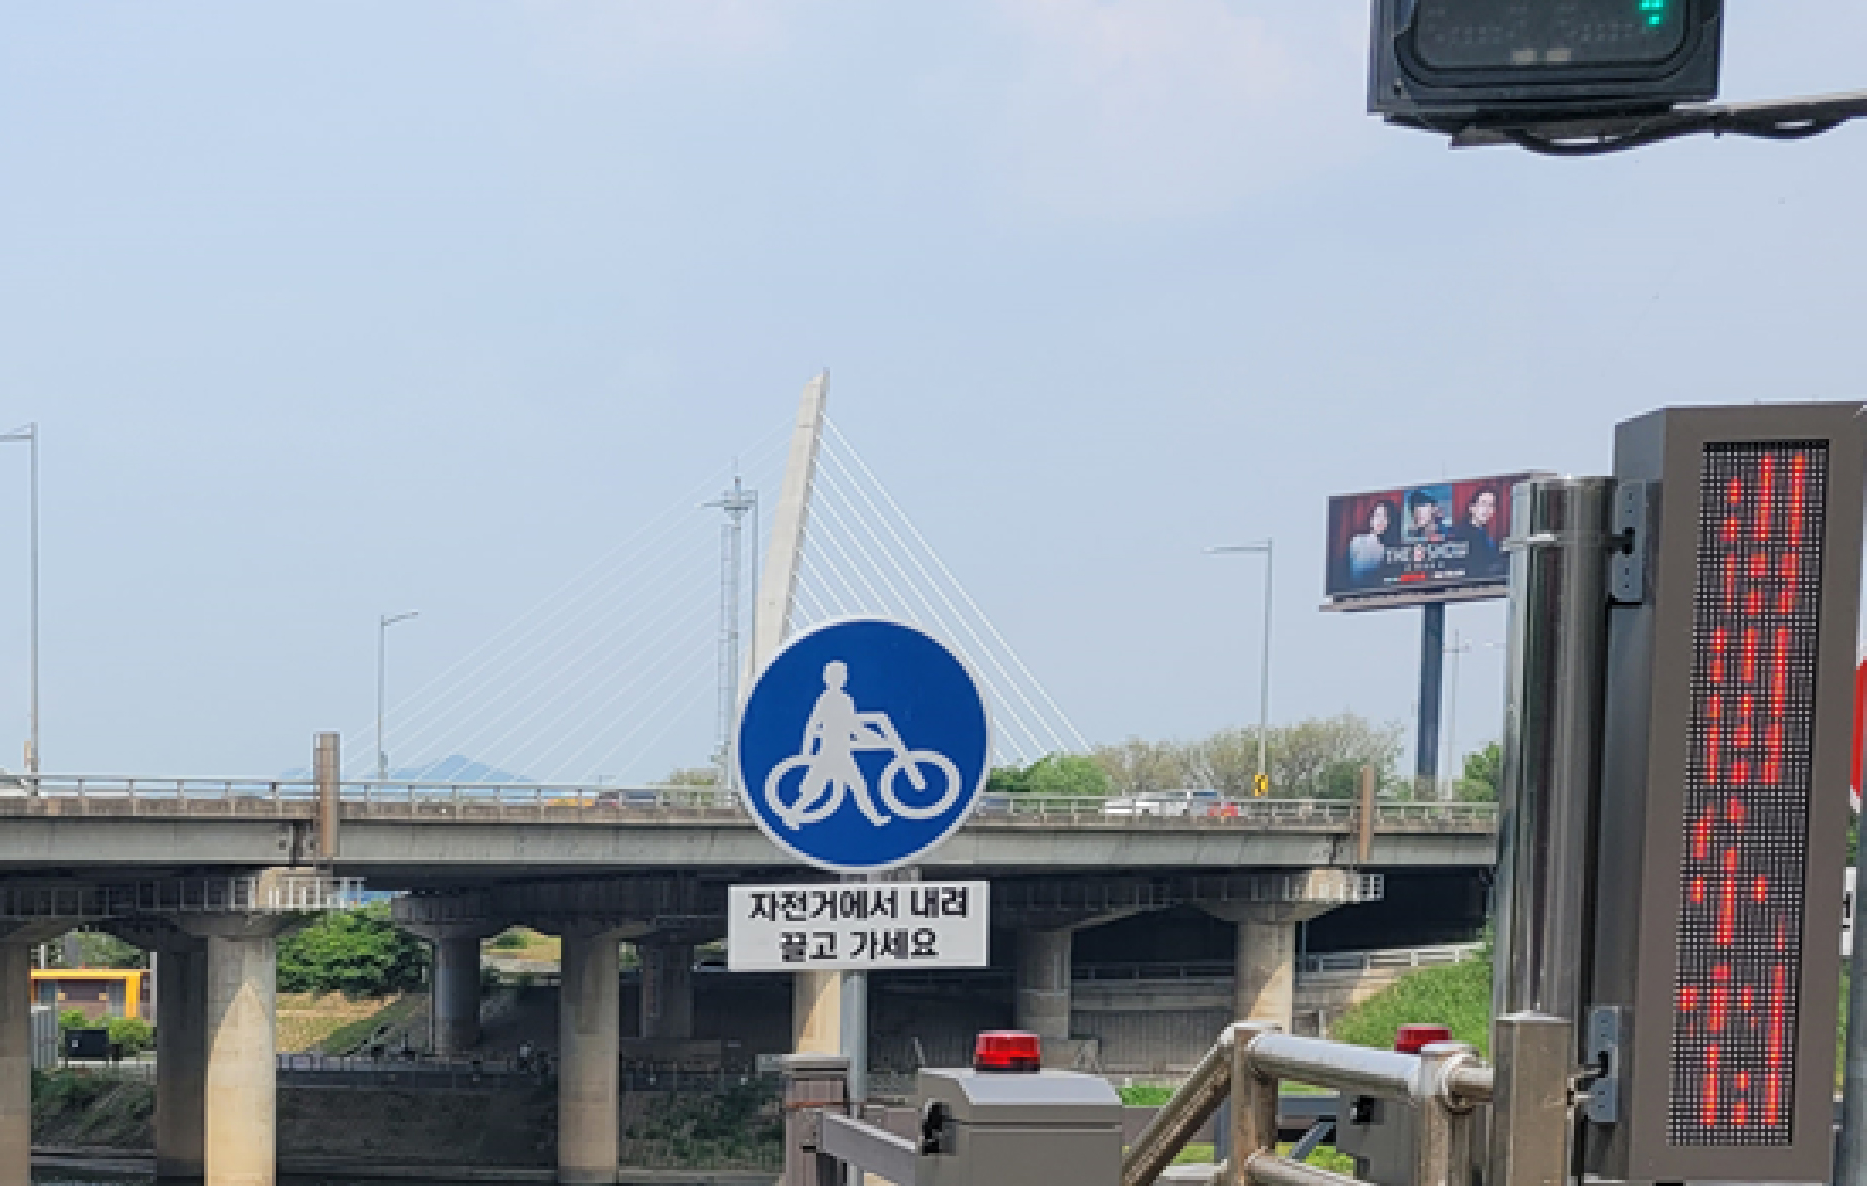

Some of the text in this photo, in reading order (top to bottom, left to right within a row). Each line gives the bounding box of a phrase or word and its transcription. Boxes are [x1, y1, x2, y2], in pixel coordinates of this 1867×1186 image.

[749, 886, 968, 923] 자전거에서 내려
[780, 928, 939, 963] 끌고 가세요
